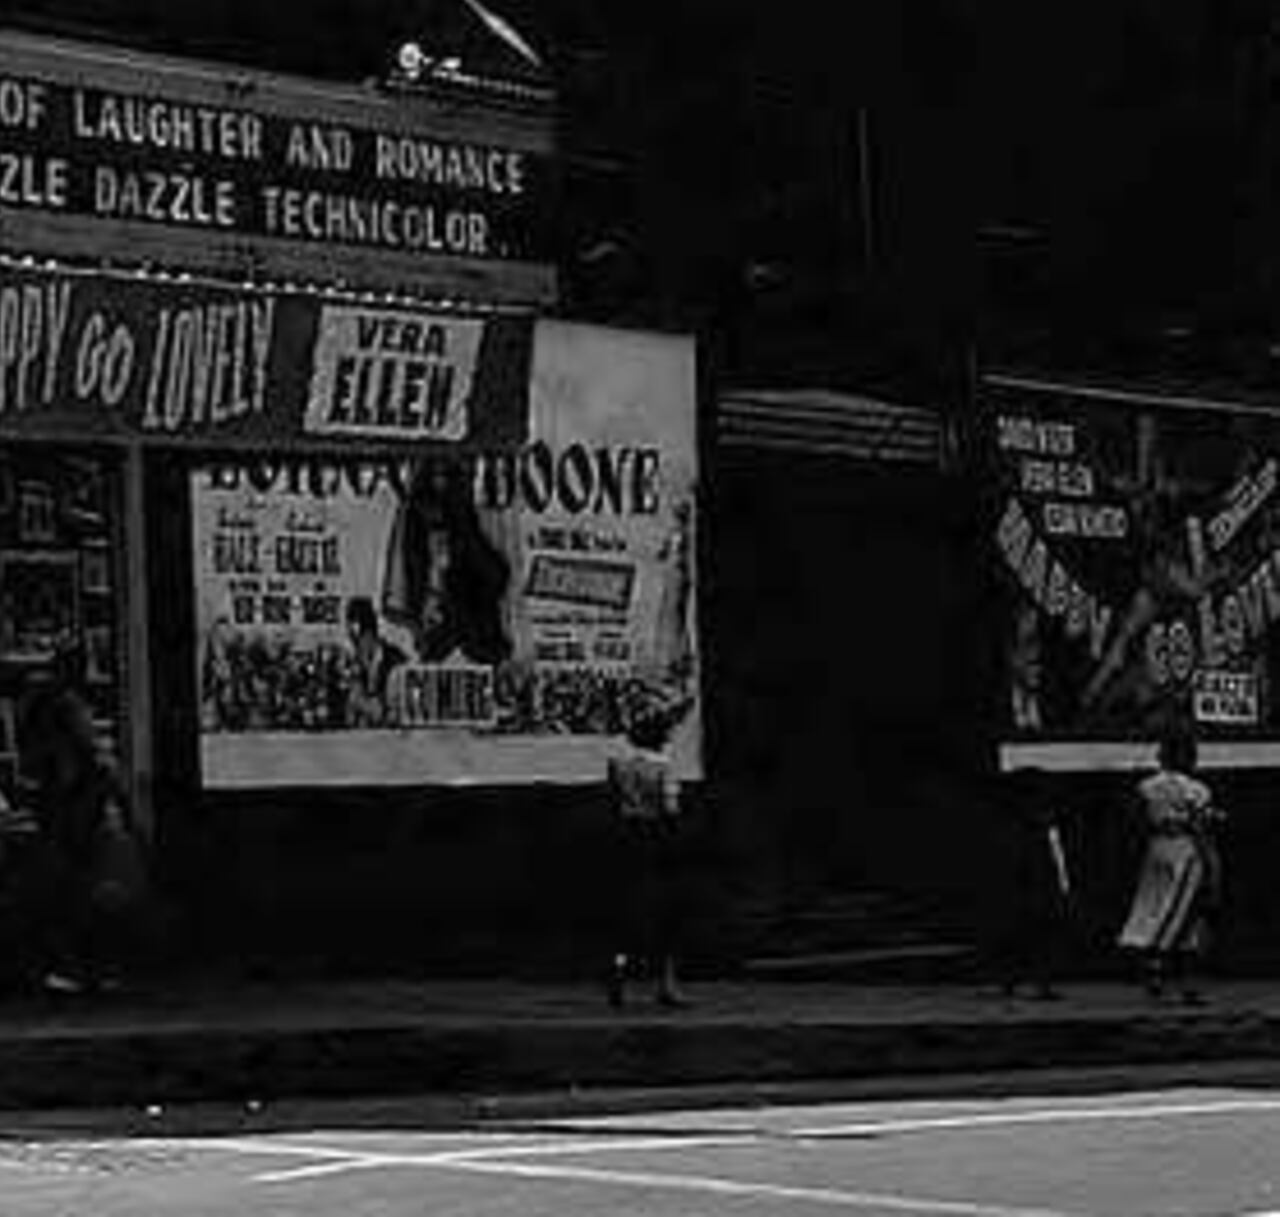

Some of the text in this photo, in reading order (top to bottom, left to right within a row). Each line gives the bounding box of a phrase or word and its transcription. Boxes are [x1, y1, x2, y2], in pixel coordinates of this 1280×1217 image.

[73, 88, 263, 160] LAUGHTER
[287, 123, 354, 172] AND
[376, 133, 523, 194] ROMANCE
[94, 166, 238, 228] DAZZLE
[74, 314, 135, 406] GO
[142, 298, 274, 430] LOVELY
[358, 315, 445, 358] VERA
[329, 356, 455, 429] ELLEN
